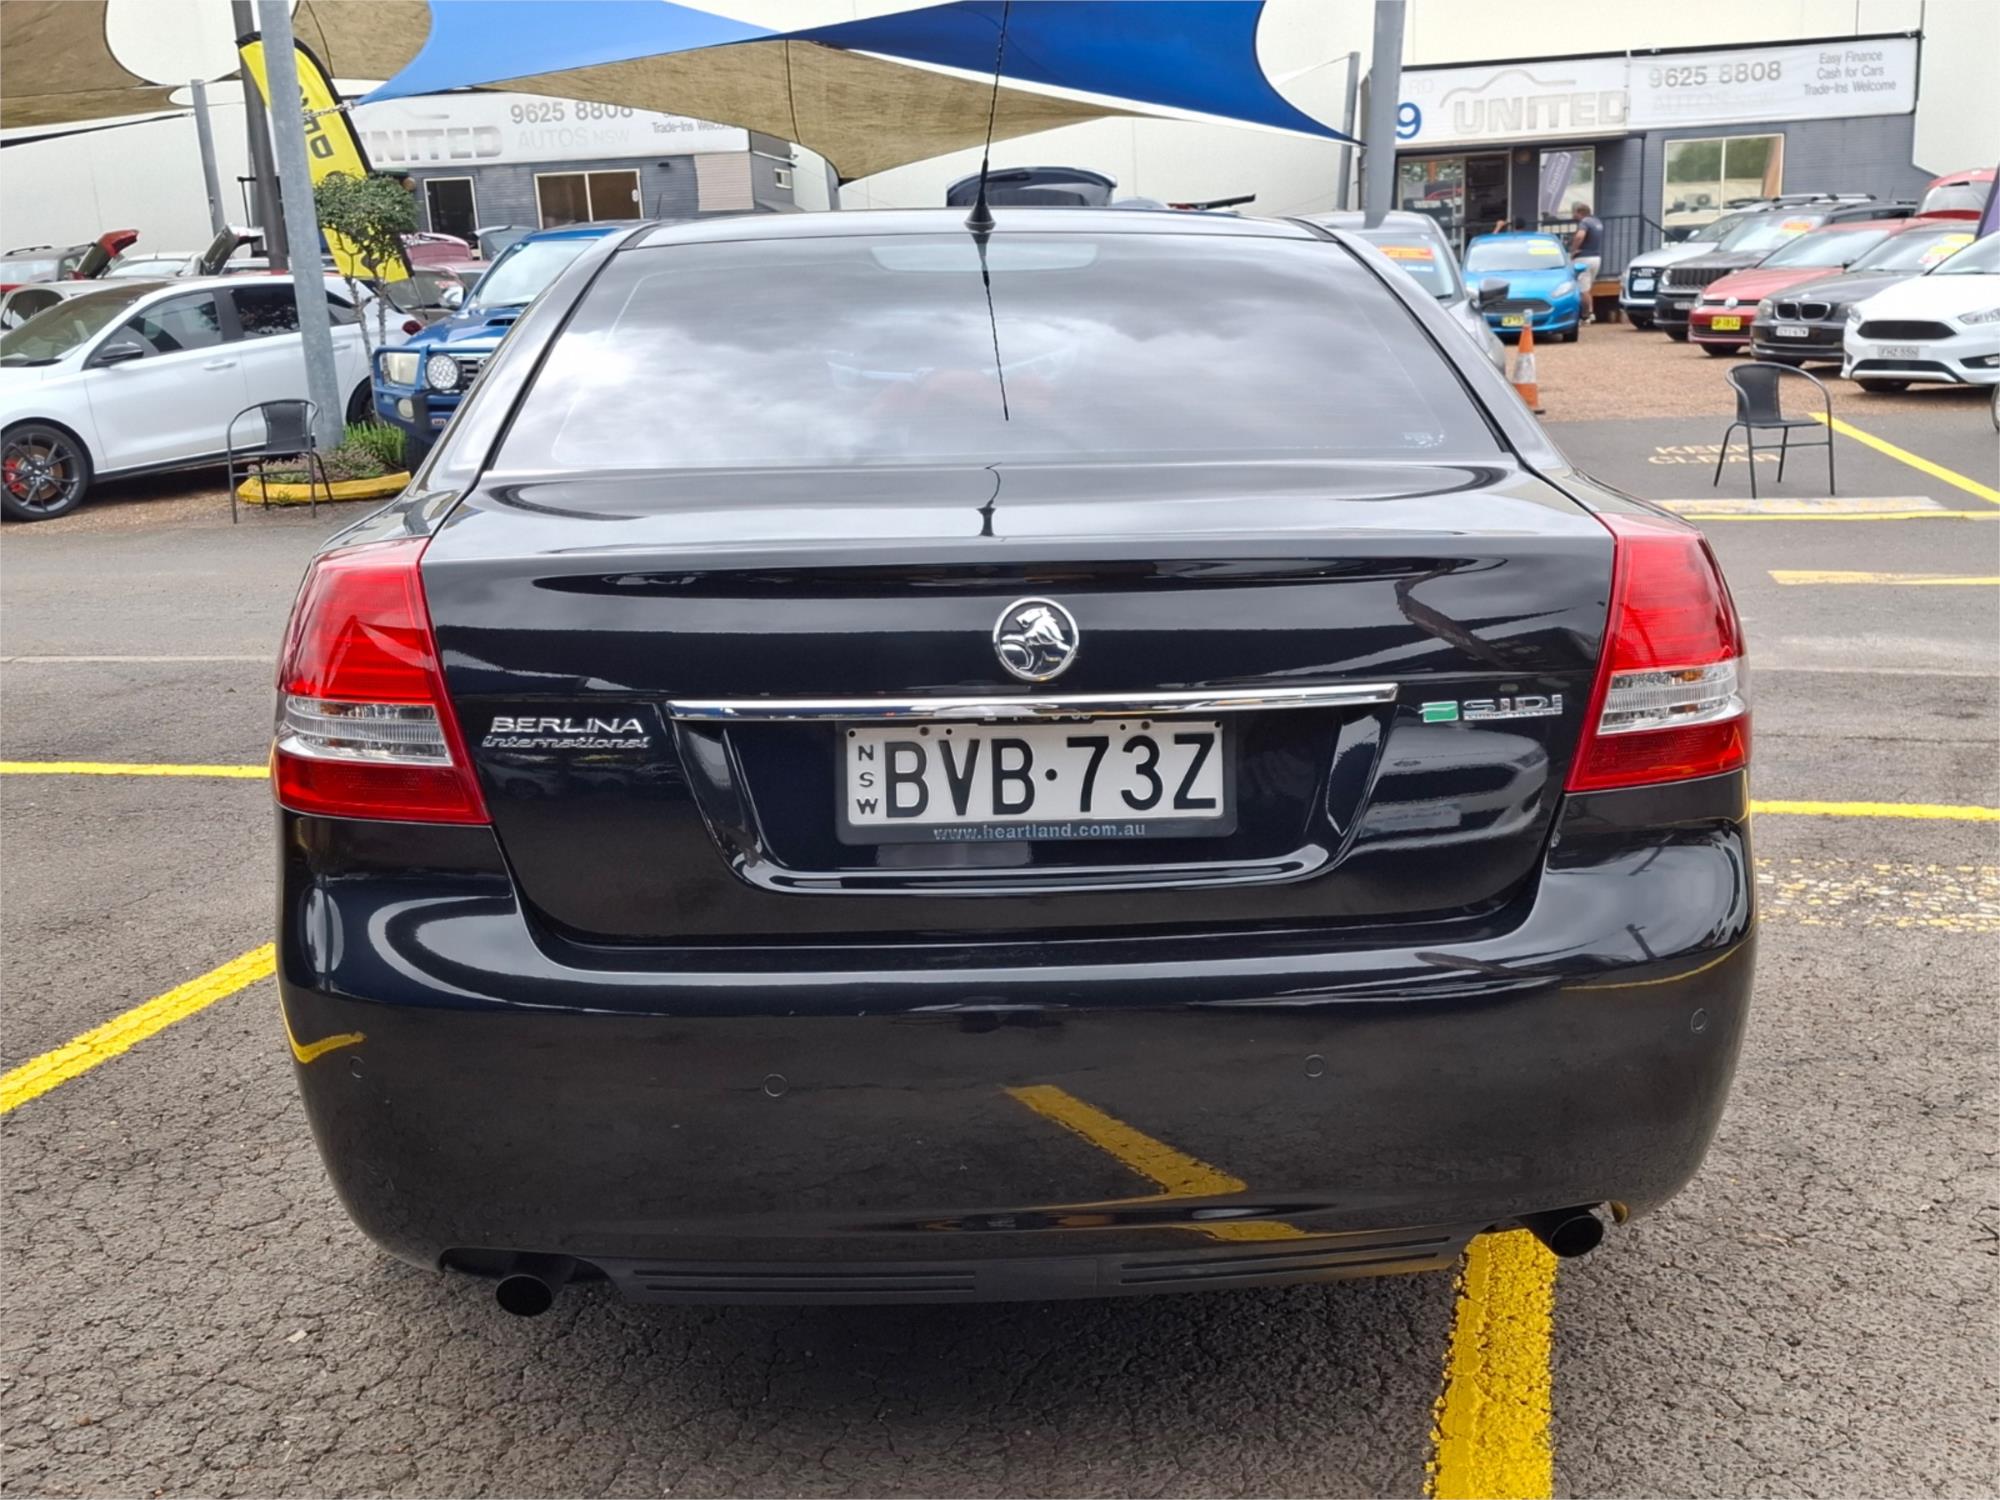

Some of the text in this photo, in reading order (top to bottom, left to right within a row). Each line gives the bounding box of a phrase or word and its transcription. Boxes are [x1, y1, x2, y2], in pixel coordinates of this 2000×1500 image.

[1819, 51, 1882, 65] Easy Finance
[1649, 60, 1783, 88] 9625 8808
[1817, 64, 1884, 80] Cash for Cars
[1804, 80, 1896, 96] Trade-Ins Welcome
[511, 103, 565, 124] 9625
[1453, 91, 1626, 135] UNITED
[652, 121, 694, 134] Trade-Ins
[517, 128, 630, 151] AUTOS NSW
[490, 716, 644, 734] BERLINA
[933, 823, 1147, 839] www.heartland.com.au
